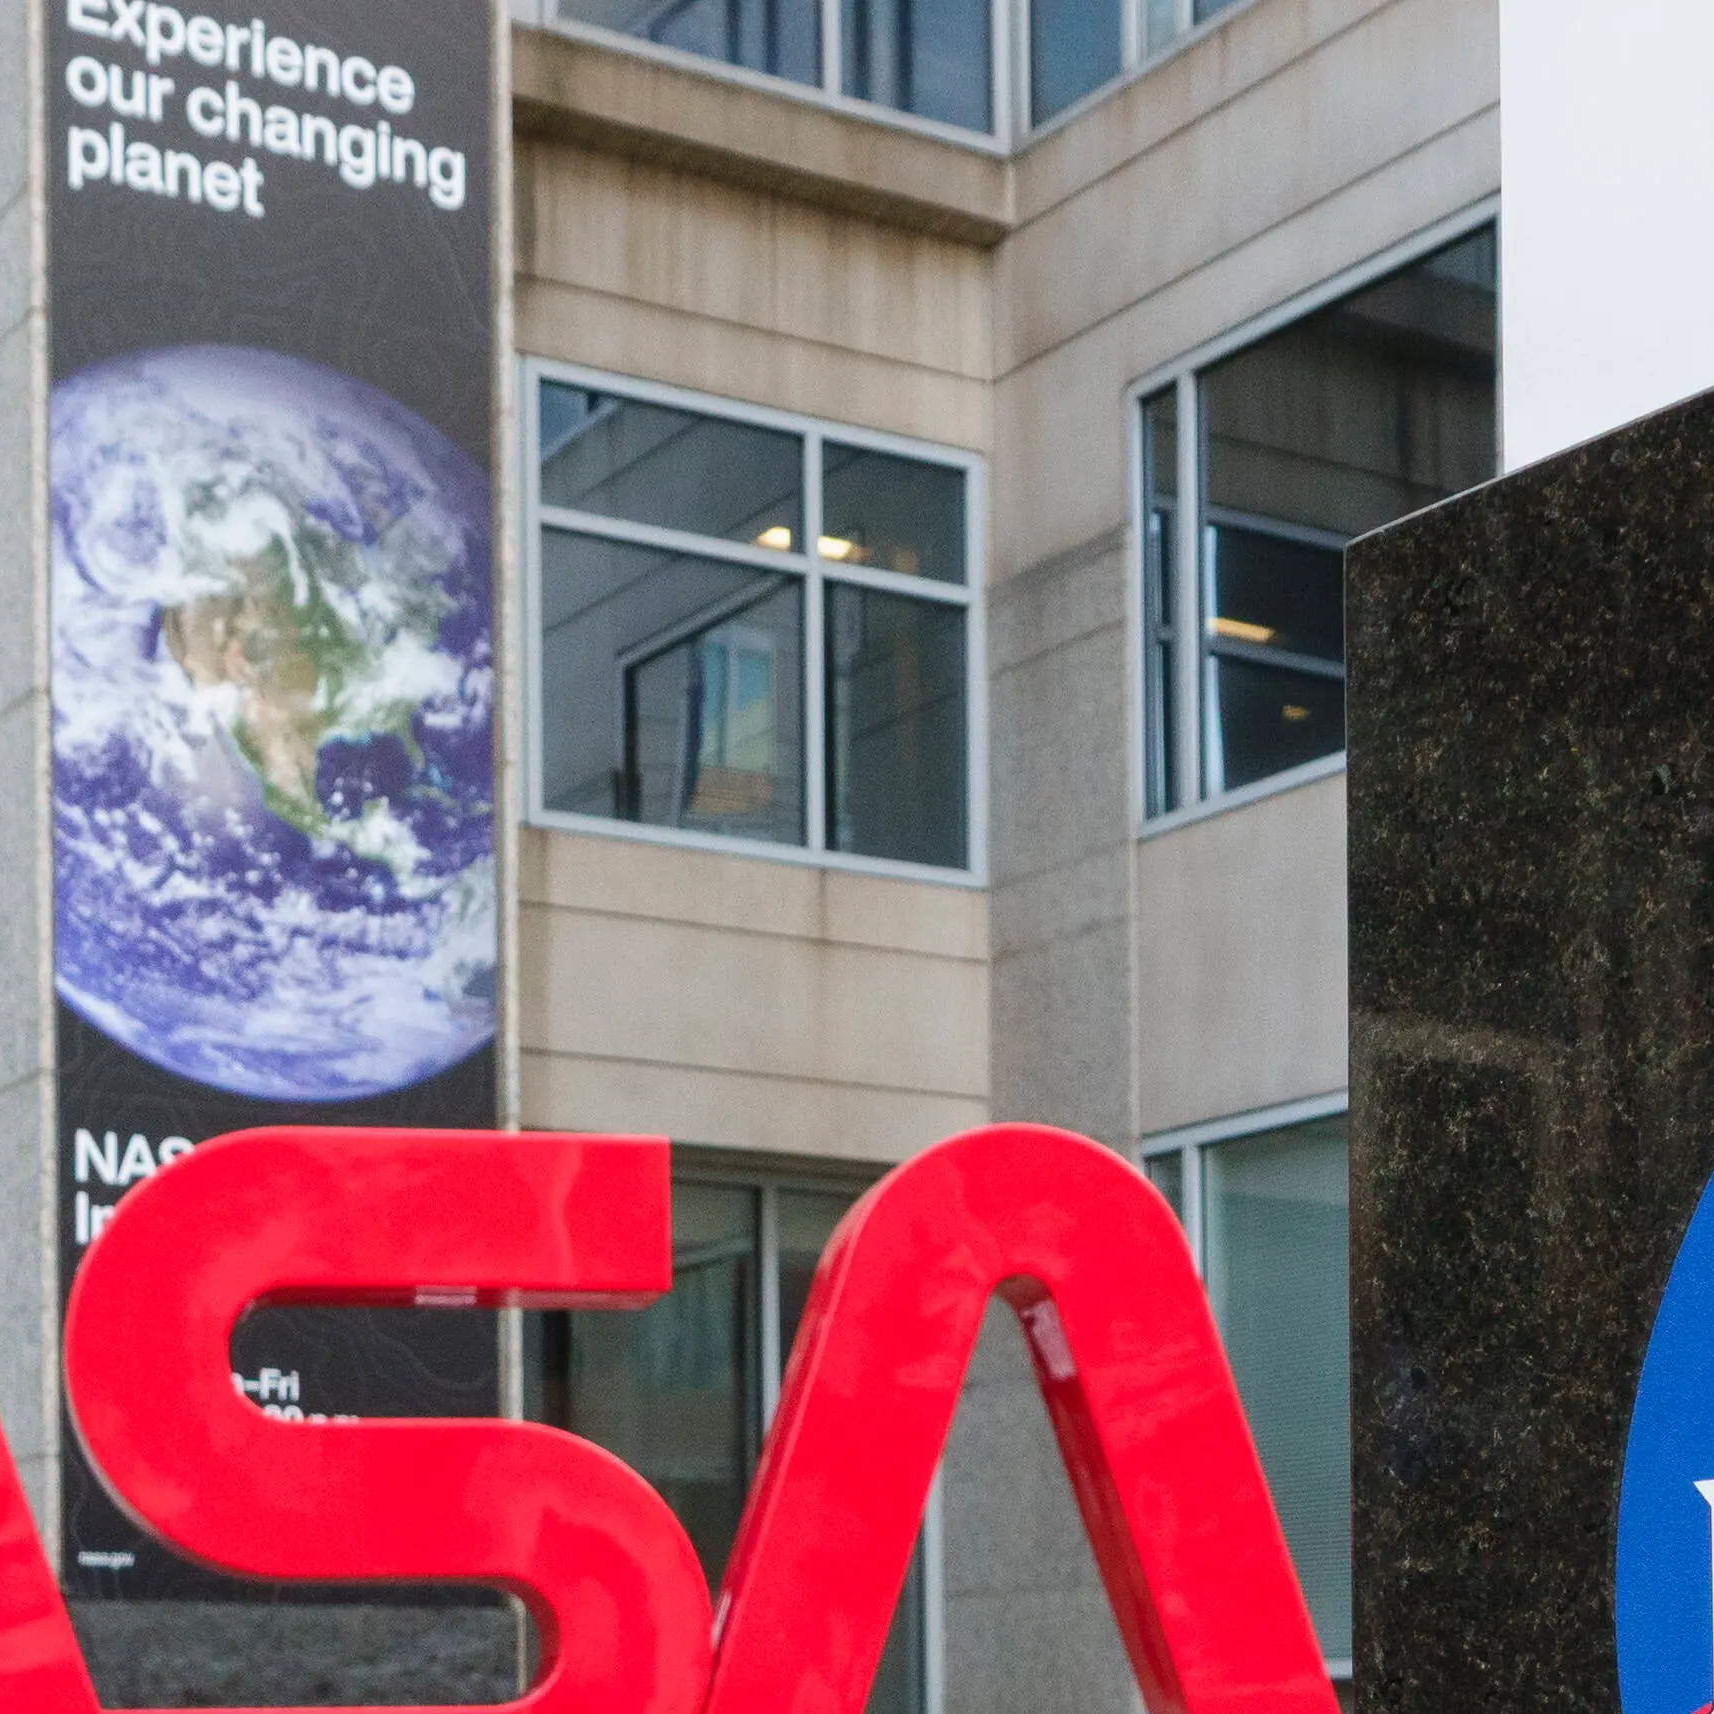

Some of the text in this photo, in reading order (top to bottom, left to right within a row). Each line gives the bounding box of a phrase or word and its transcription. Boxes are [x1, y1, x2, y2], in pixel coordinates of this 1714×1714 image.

[66, 0, 416, 115] Experience
[66, 55, 468, 211] our changing
[67, 122, 266, 218] planet
[75, 1128, 195, 1186] NAS
